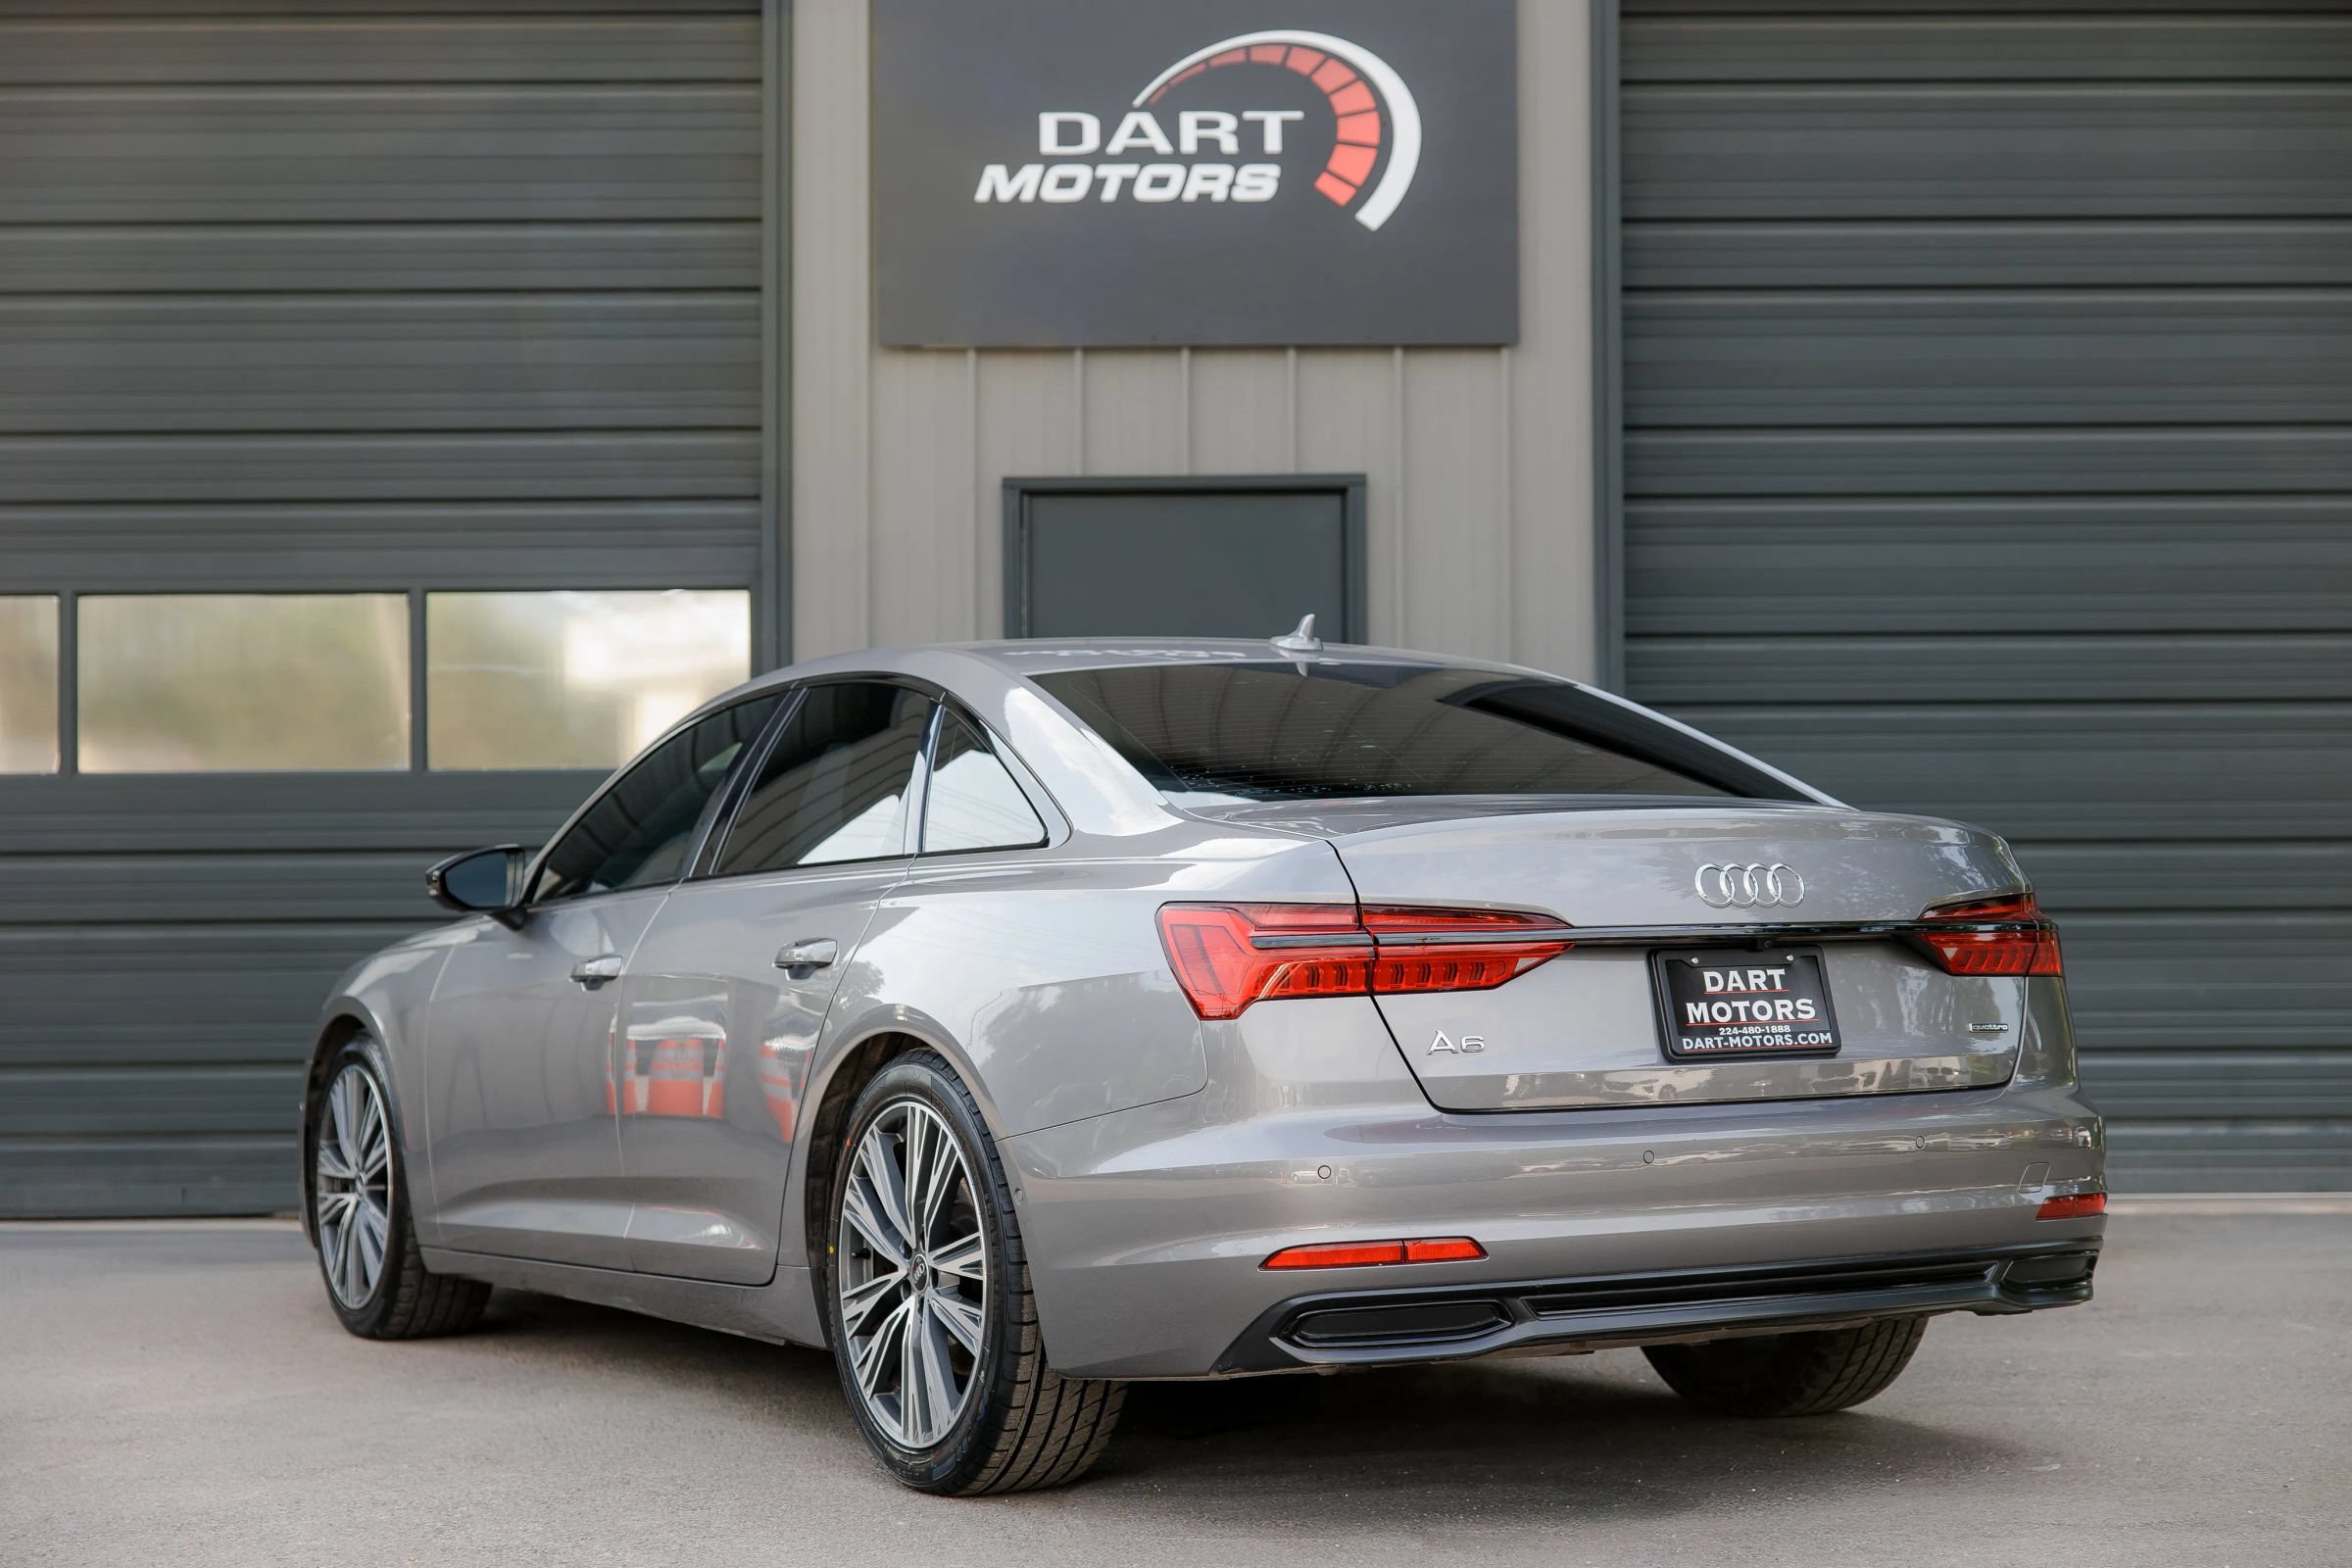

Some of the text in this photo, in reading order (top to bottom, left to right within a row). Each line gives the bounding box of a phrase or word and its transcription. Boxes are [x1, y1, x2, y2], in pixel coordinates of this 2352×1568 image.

[1039, 110, 1304, 155] DART
[974, 163, 1282, 202] MOTORS
[1703, 968, 1786, 993] DART
[1686, 999, 1816, 1023] MOTORS
[1427, 1030, 1485, 1055] A6
[1683, 1032, 1833, 1050] DART-MOTORS.COM
[1719, 1025, 1791, 1036] 224-480-1888
